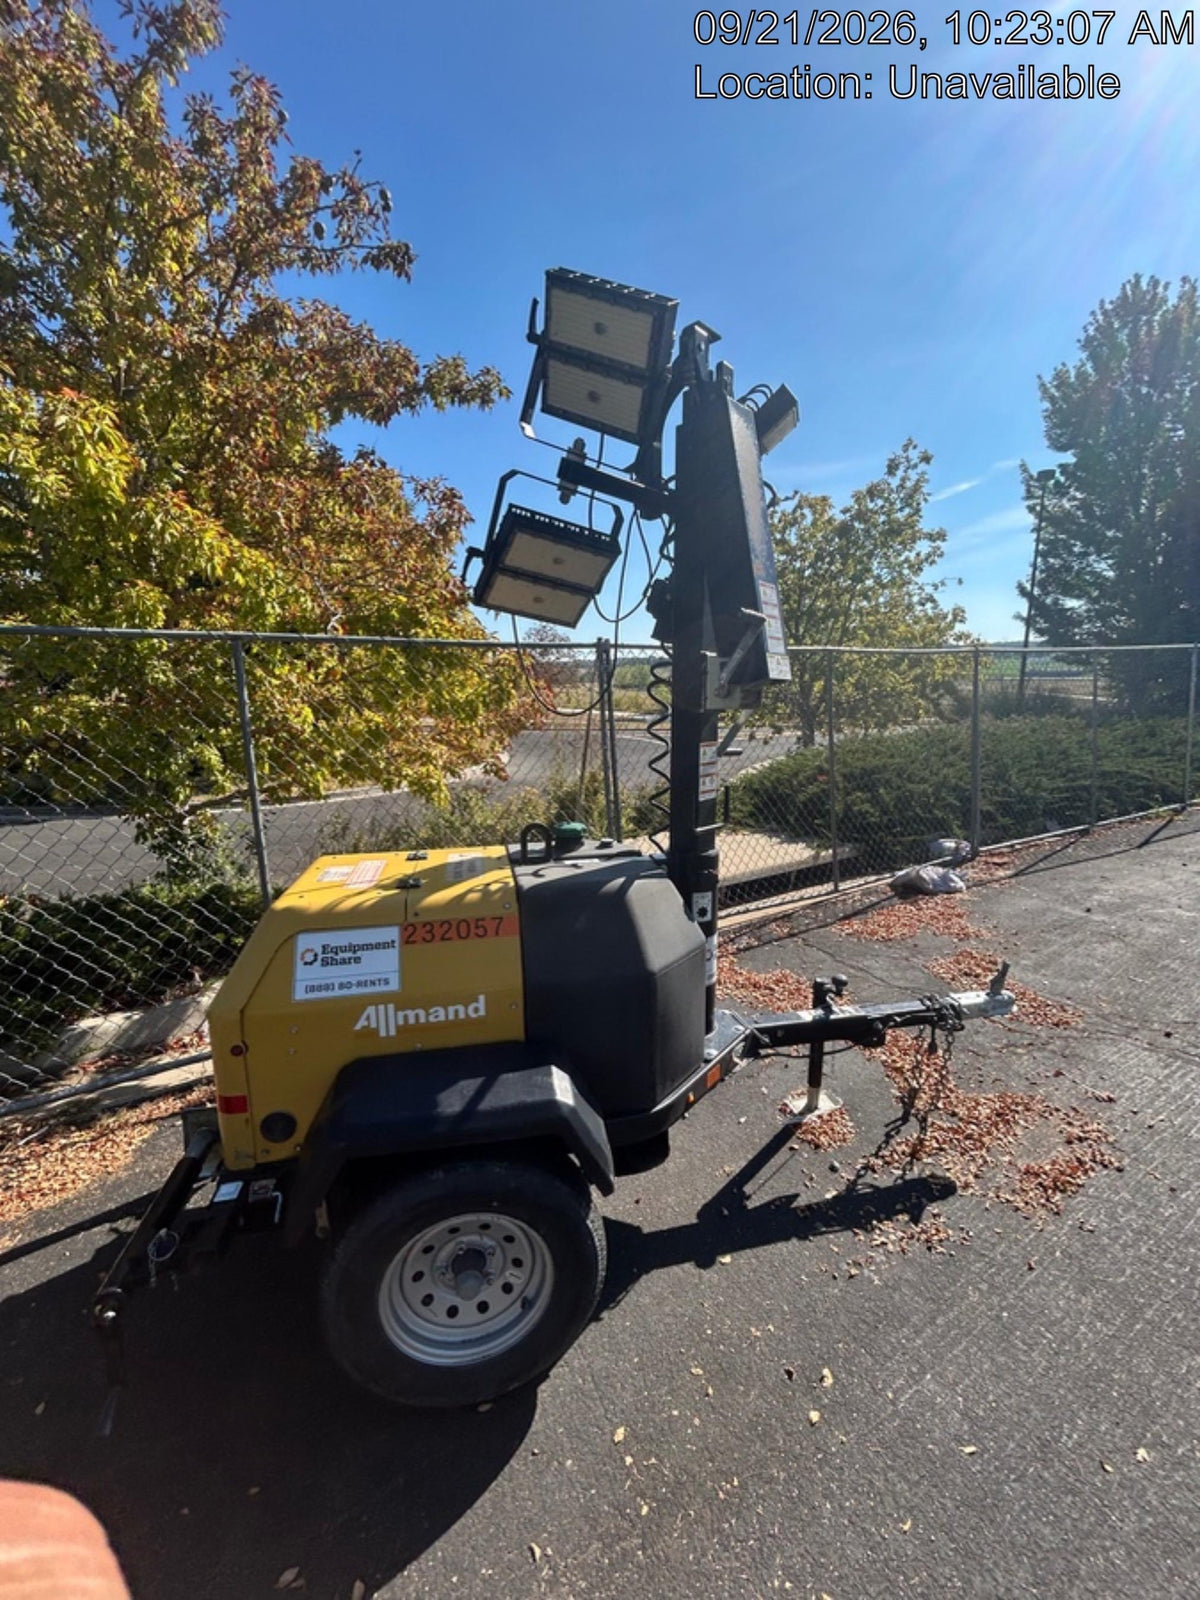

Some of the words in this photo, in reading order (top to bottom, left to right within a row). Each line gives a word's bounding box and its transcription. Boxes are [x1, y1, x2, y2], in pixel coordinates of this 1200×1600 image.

[403, 917, 505, 945] 232057
[320, 939, 397, 956] Equipment
[320, 955, 362, 967] Share
[353, 994, 487, 1037] Allmand
